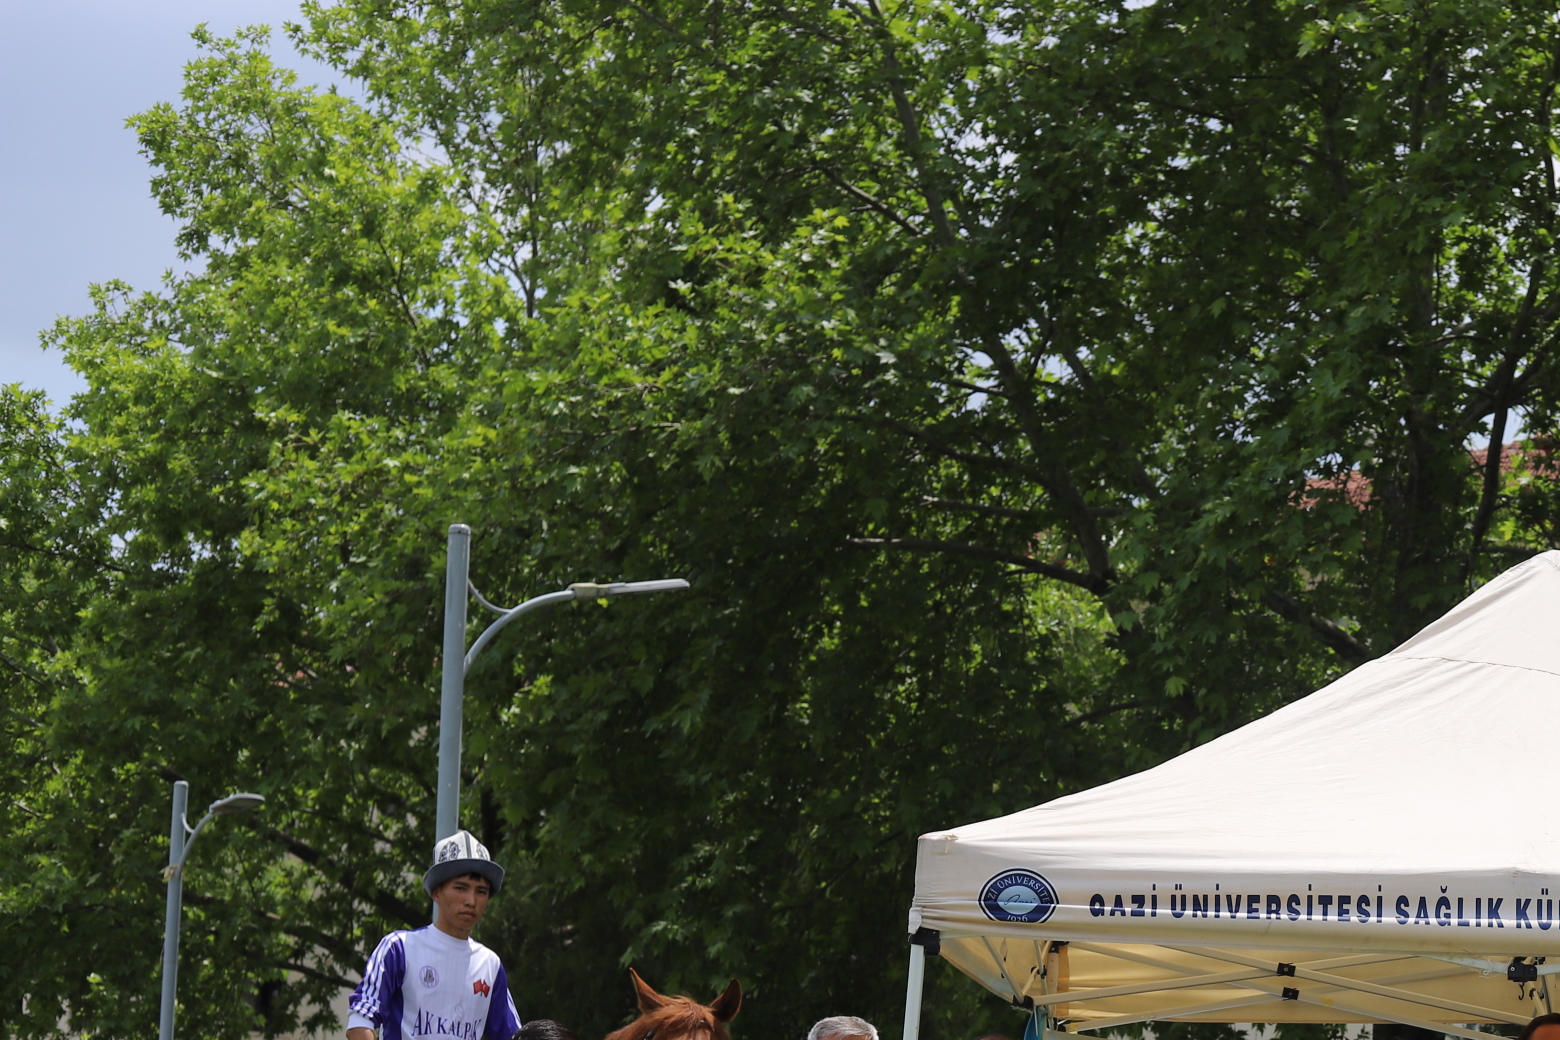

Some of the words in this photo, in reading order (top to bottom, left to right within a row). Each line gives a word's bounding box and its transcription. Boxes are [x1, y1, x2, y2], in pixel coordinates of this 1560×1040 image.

[1170, 883, 1383, 924] ÜNİVERSİTESİ
[1395, 886, 1504, 929] SAĞLIK
[411, 1006, 435, 1036] AK
